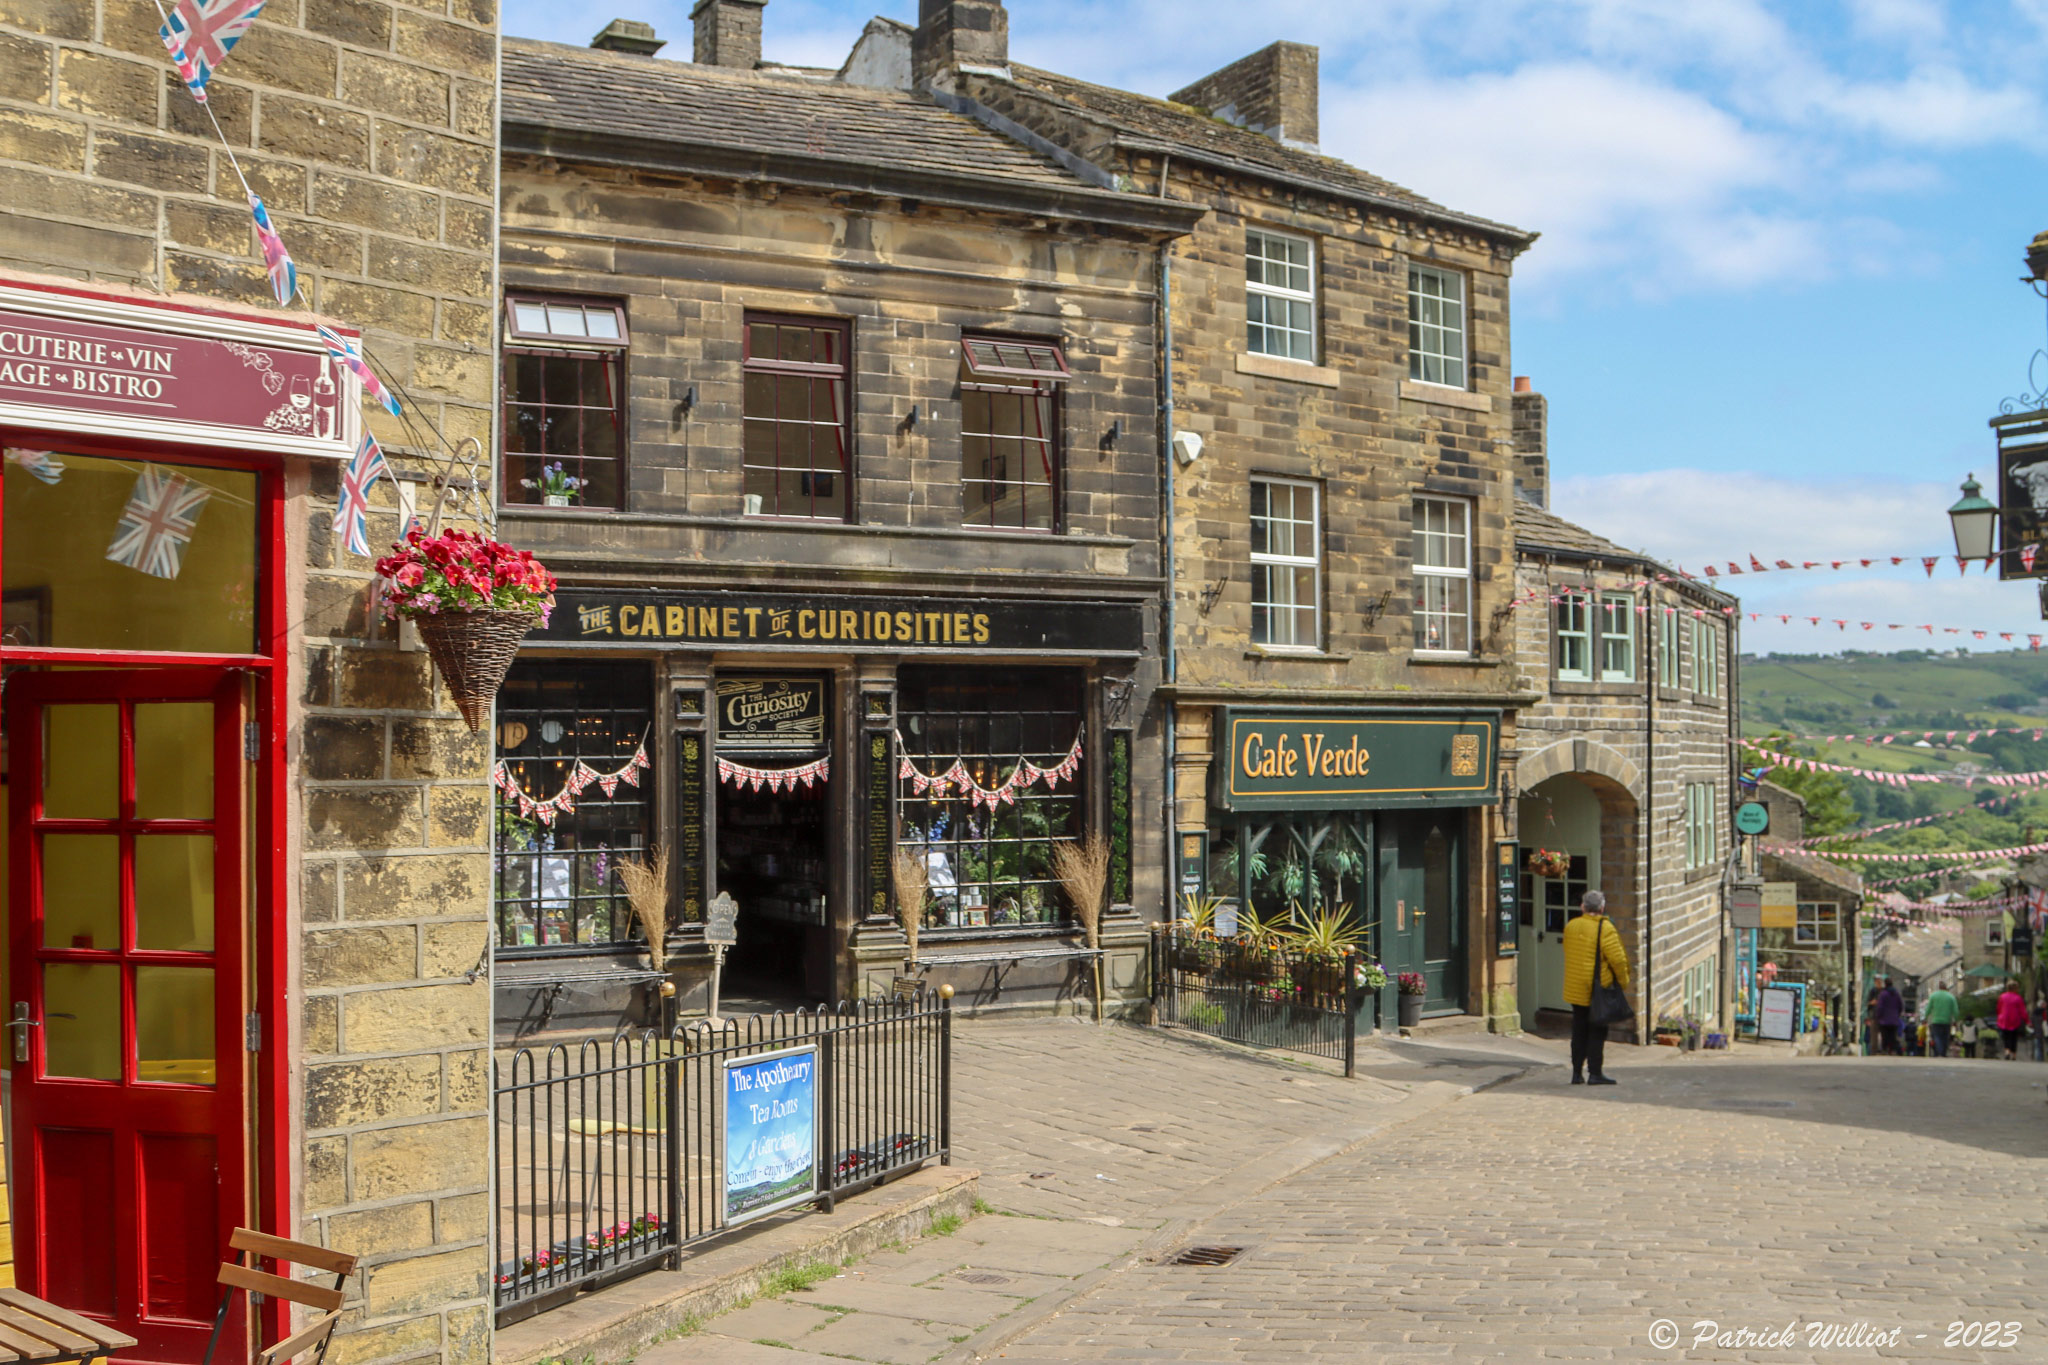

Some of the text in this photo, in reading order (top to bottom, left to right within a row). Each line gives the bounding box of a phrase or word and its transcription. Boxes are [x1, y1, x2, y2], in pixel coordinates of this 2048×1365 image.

[0, 331, 107, 365] CUTERIE
[125, 347, 172, 372] VIN
[0, 361, 51, 386] AGE
[72, 369, 163, 399] BISTRO
[580, 605, 989, 643] THE CABINET OF CURIOSITIES
[727, 690, 812, 726] Curiosity
[749, 693, 763, 702] THE
[769, 708, 799, 721] SOCIETY
[1242, 732, 1370, 778] Cafe Verde
[712, 903, 733, 915] OPEN
[732, 1068, 752, 1092] The
[750, 1103, 769, 1125] Tea
